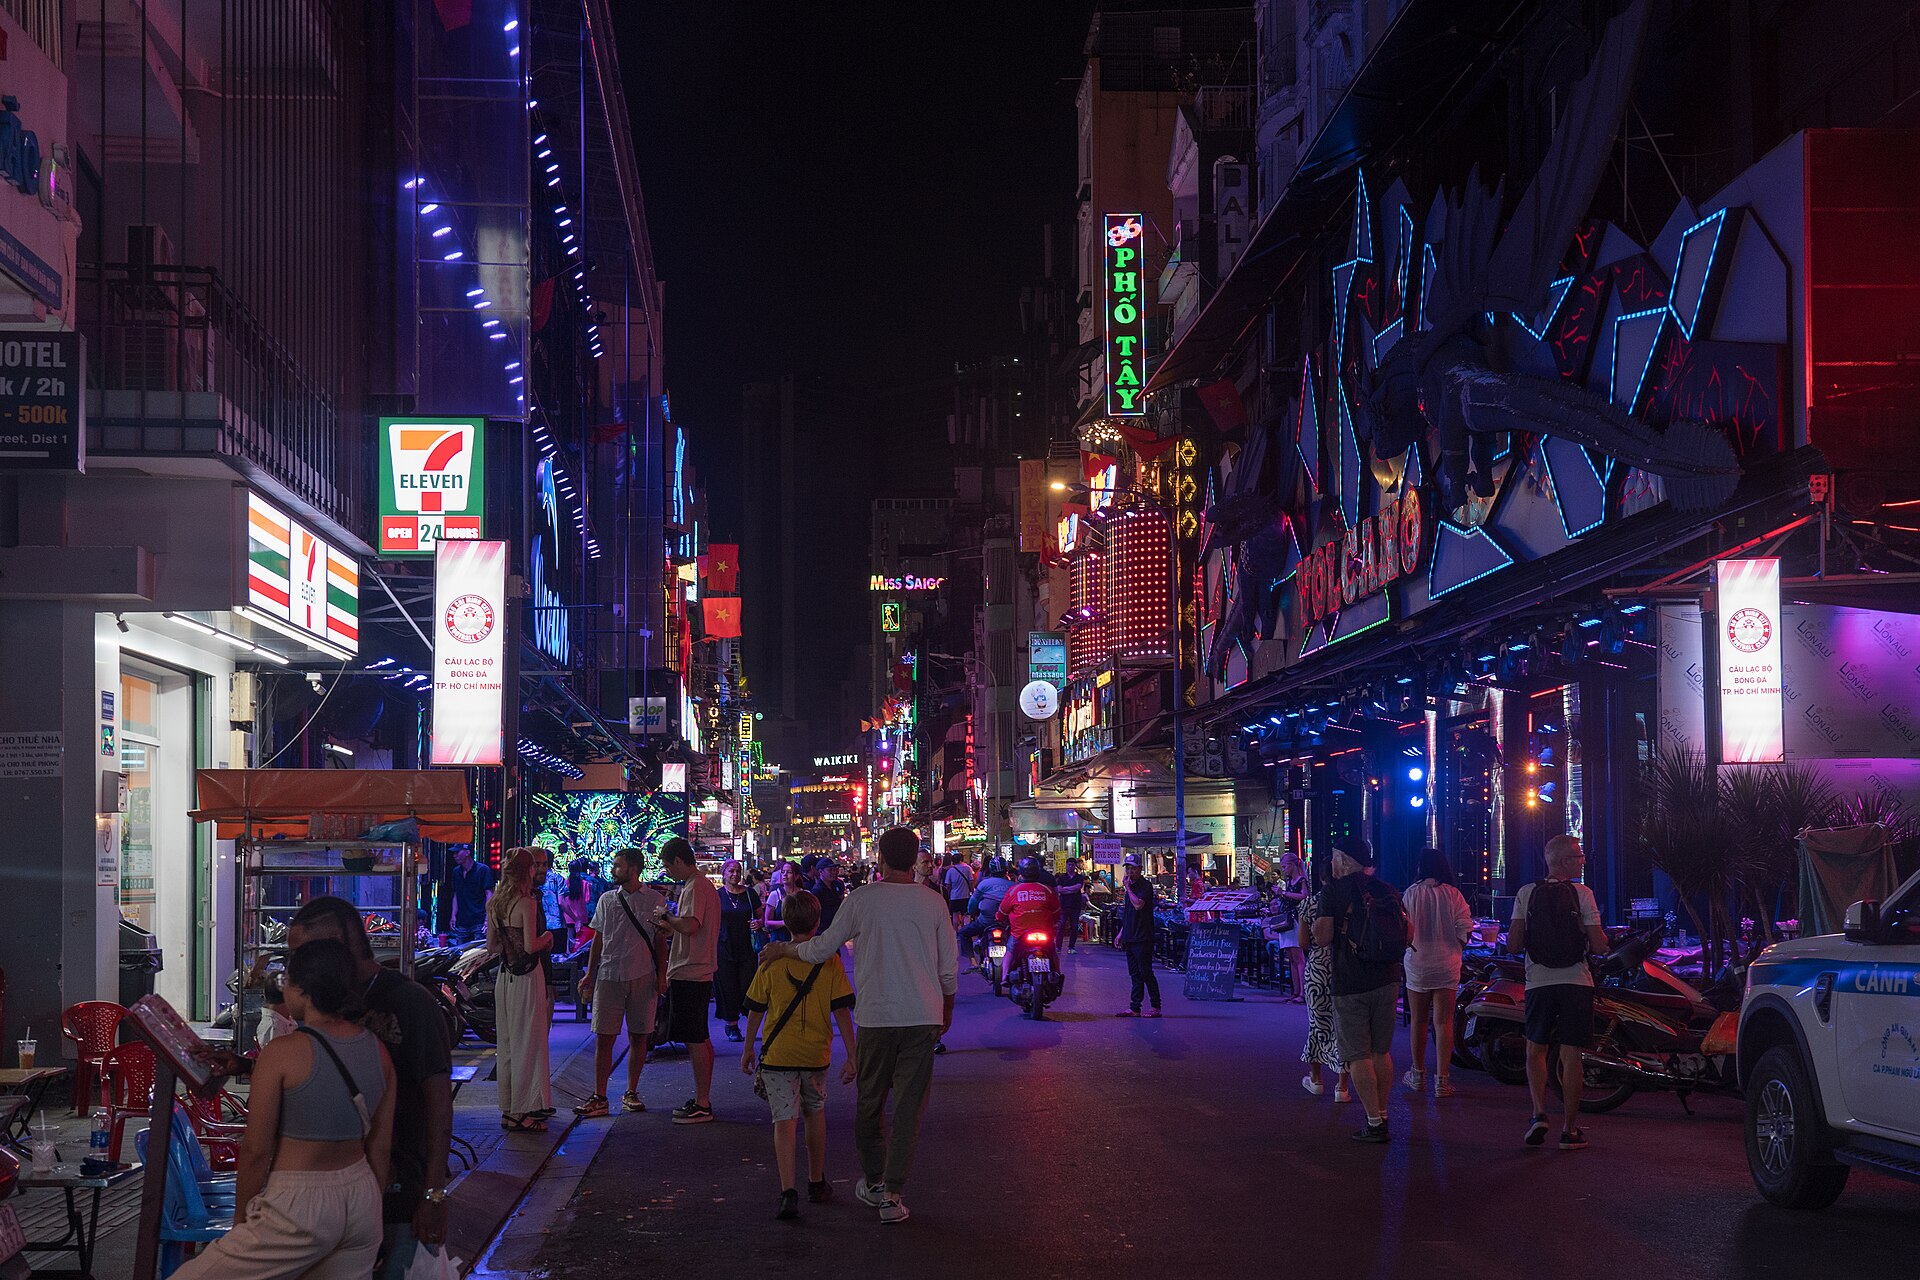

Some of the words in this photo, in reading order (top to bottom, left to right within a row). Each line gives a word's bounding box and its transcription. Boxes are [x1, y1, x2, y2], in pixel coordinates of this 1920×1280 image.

[1113, 248, 1138, 324] PHỐ
[1115, 335, 1140, 410] TÂY
[36, 377, 65, 396] 2h
[18, 405, 68, 424] 500k
[32, 433, 58, 444] Dist
[61, 434, 67, 444] 1
[387, 527, 414, 539] OPEN
[420, 523, 445, 543] 24
[1295, 487, 1422, 629] VOLCANO
[1032, 671, 1064, 680] Massage
[480, 683, 502, 691] MINH
[965, 713, 975, 754] TINA
[813, 754, 858, 767] WAIKIKI
[965, 758, 975, 788] SPA
[824, 813, 851, 821] WAIKIKI
[1855, 963, 1908, 993] CẢNH
